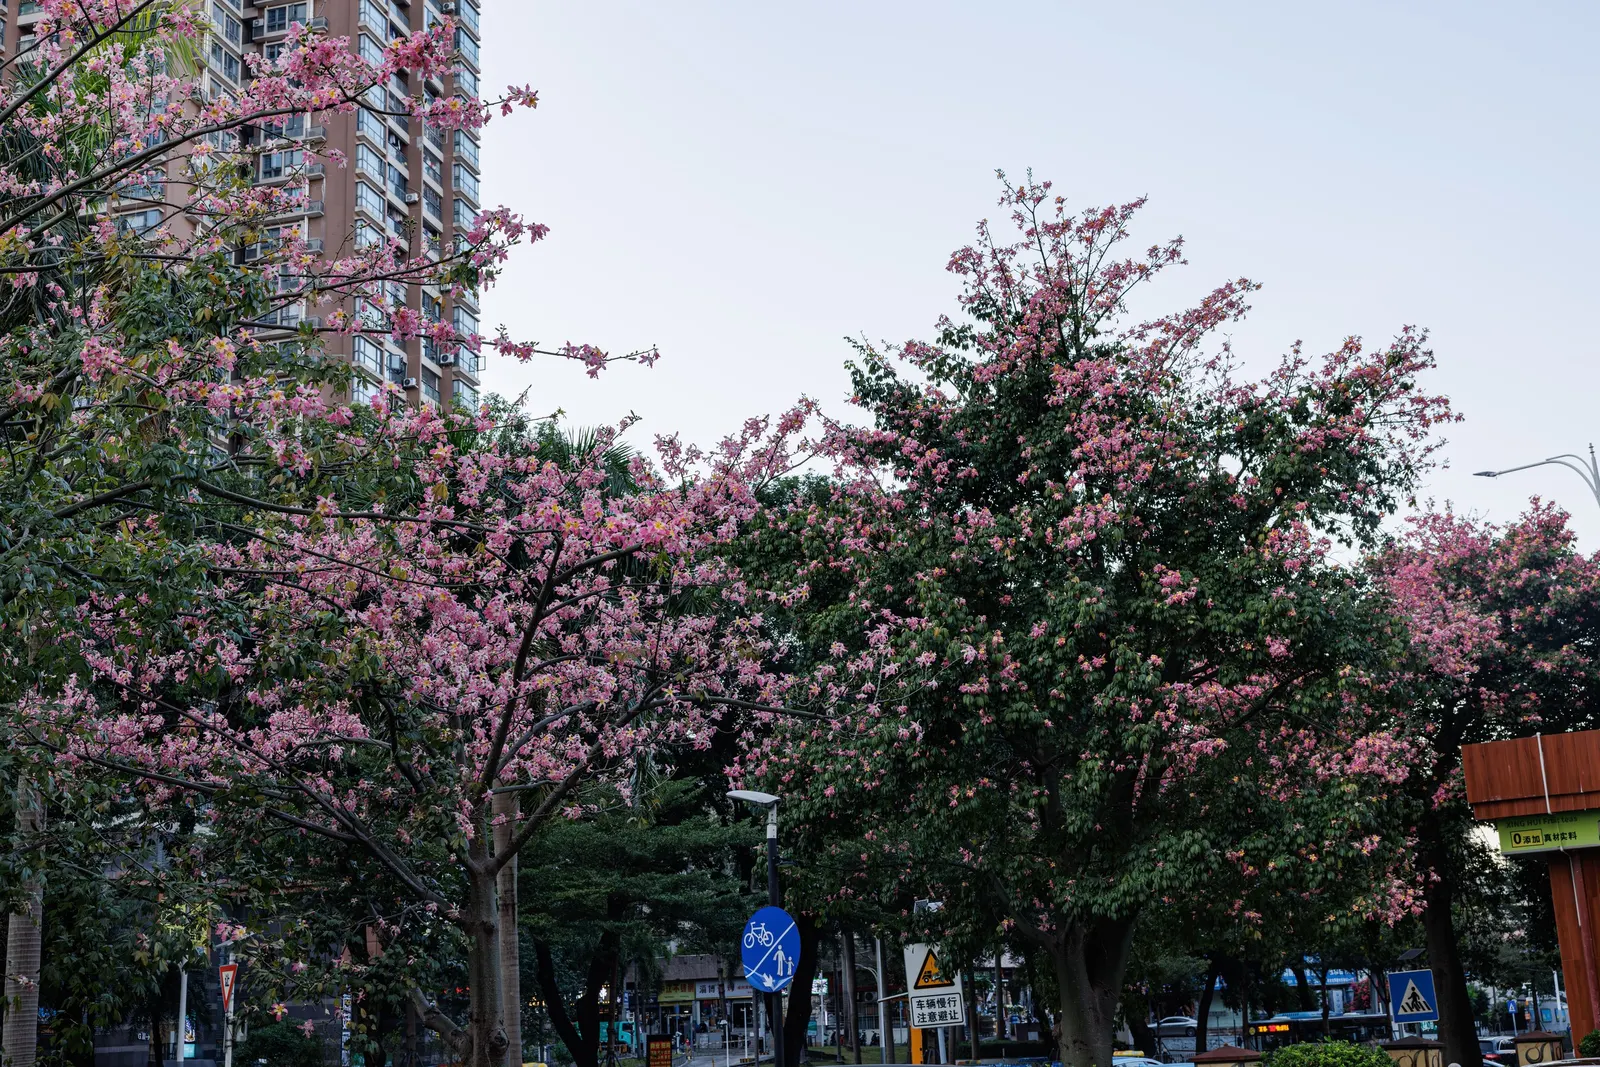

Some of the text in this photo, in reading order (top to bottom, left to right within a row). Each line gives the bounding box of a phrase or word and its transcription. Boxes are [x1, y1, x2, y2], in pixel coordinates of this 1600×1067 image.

[1506, 819, 1525, 828] XING
[1527, 818, 1542, 826] HUI
[1543, 831, 1577, 842] 真材实料
[916, 997, 957, 1010] 车辆慢行
[917, 1010, 959, 1023] 注意避让
